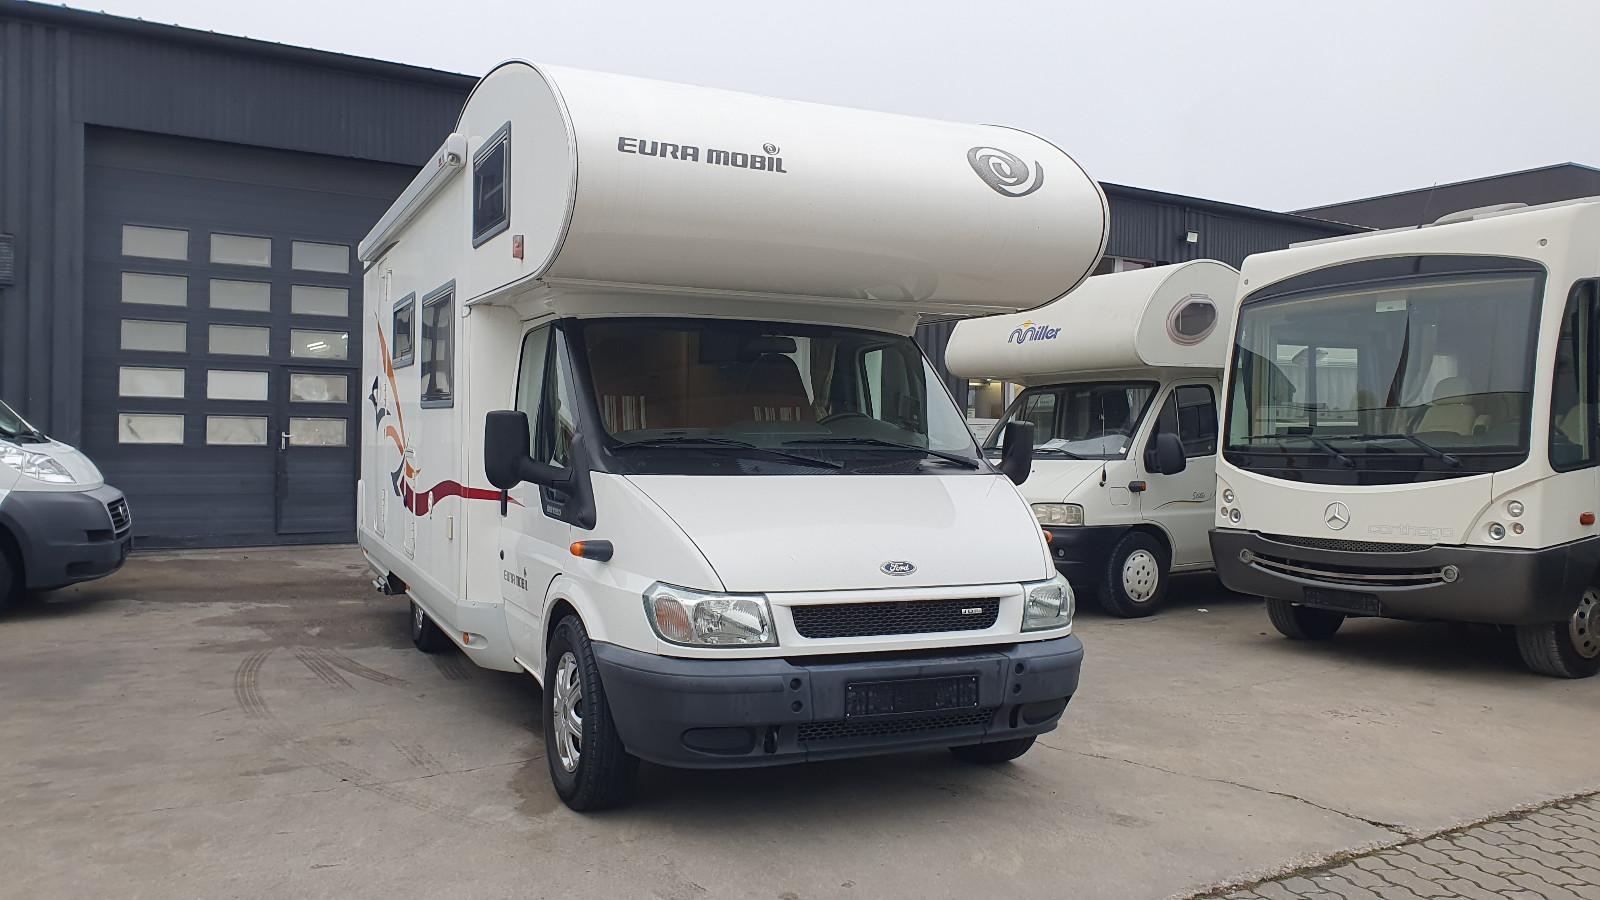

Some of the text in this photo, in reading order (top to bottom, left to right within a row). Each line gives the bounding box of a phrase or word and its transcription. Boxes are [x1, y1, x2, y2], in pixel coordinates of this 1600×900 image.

[618, 136, 788, 173] EURA MOBIL
[1008, 324, 1062, 345] Miller
